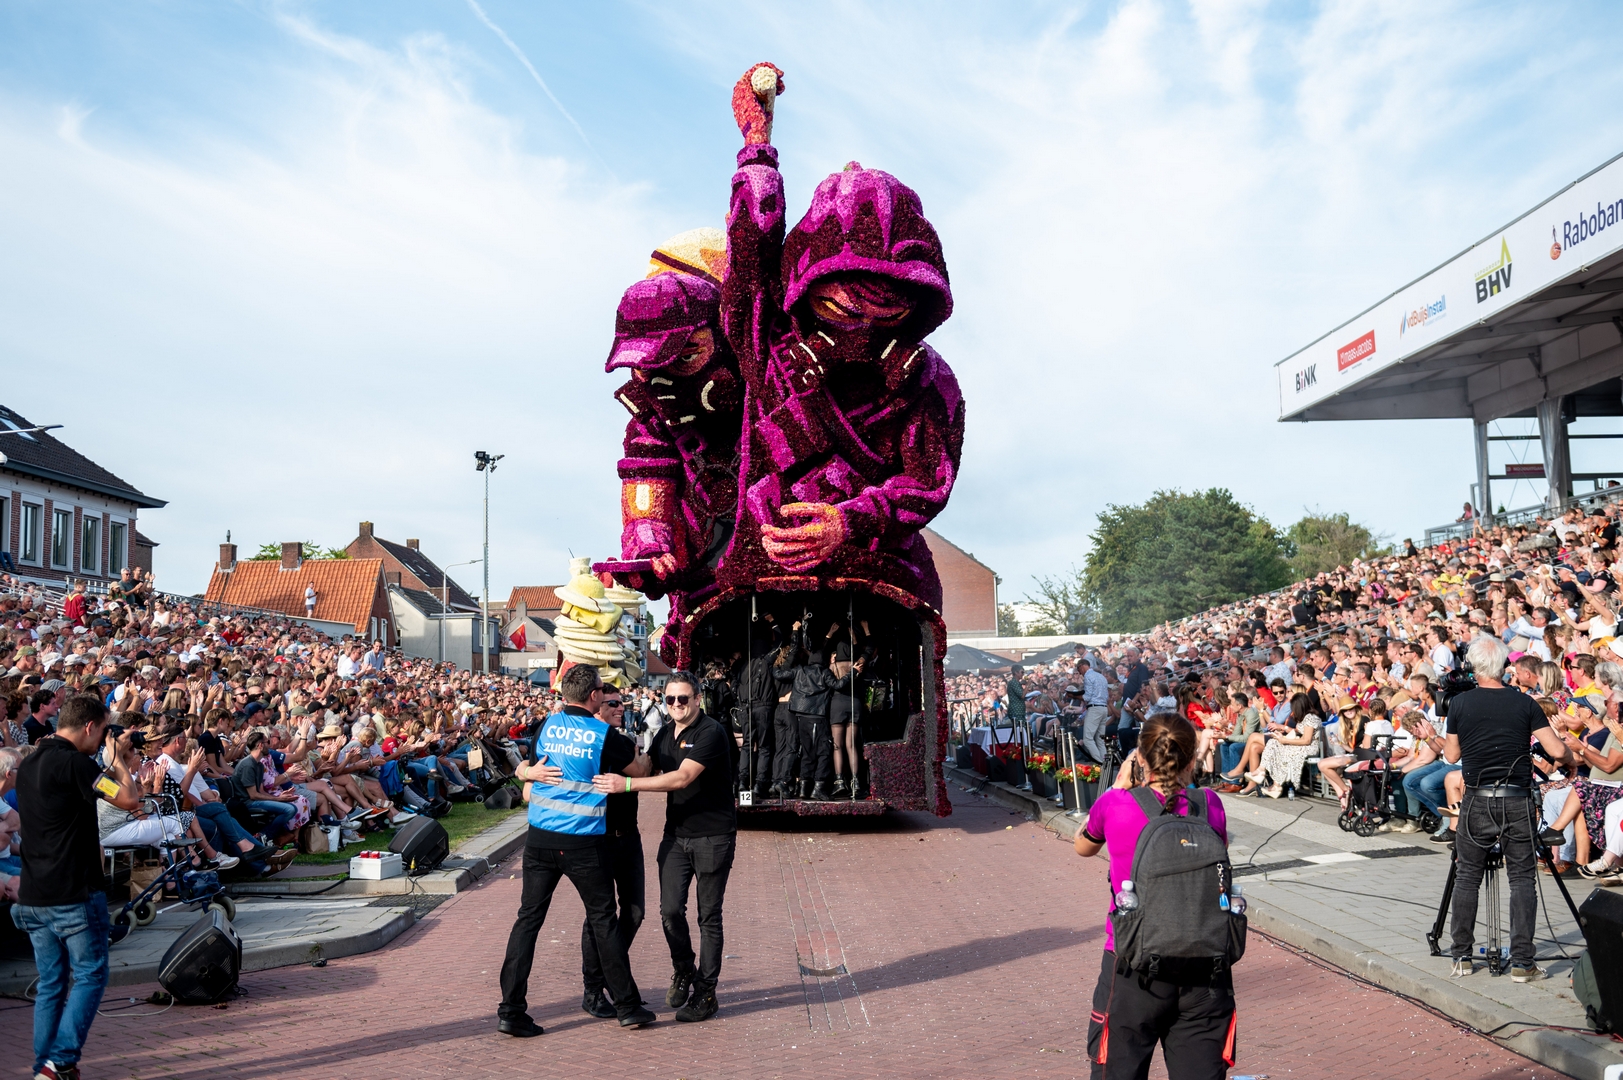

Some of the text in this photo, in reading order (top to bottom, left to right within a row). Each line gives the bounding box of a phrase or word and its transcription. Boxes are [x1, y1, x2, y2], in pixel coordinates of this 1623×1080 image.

[1475, 263, 1512, 304] BHV
[546, 725, 596, 744] corso
[543, 743, 593, 759] zundert
[741, 793, 751, 801] 12
